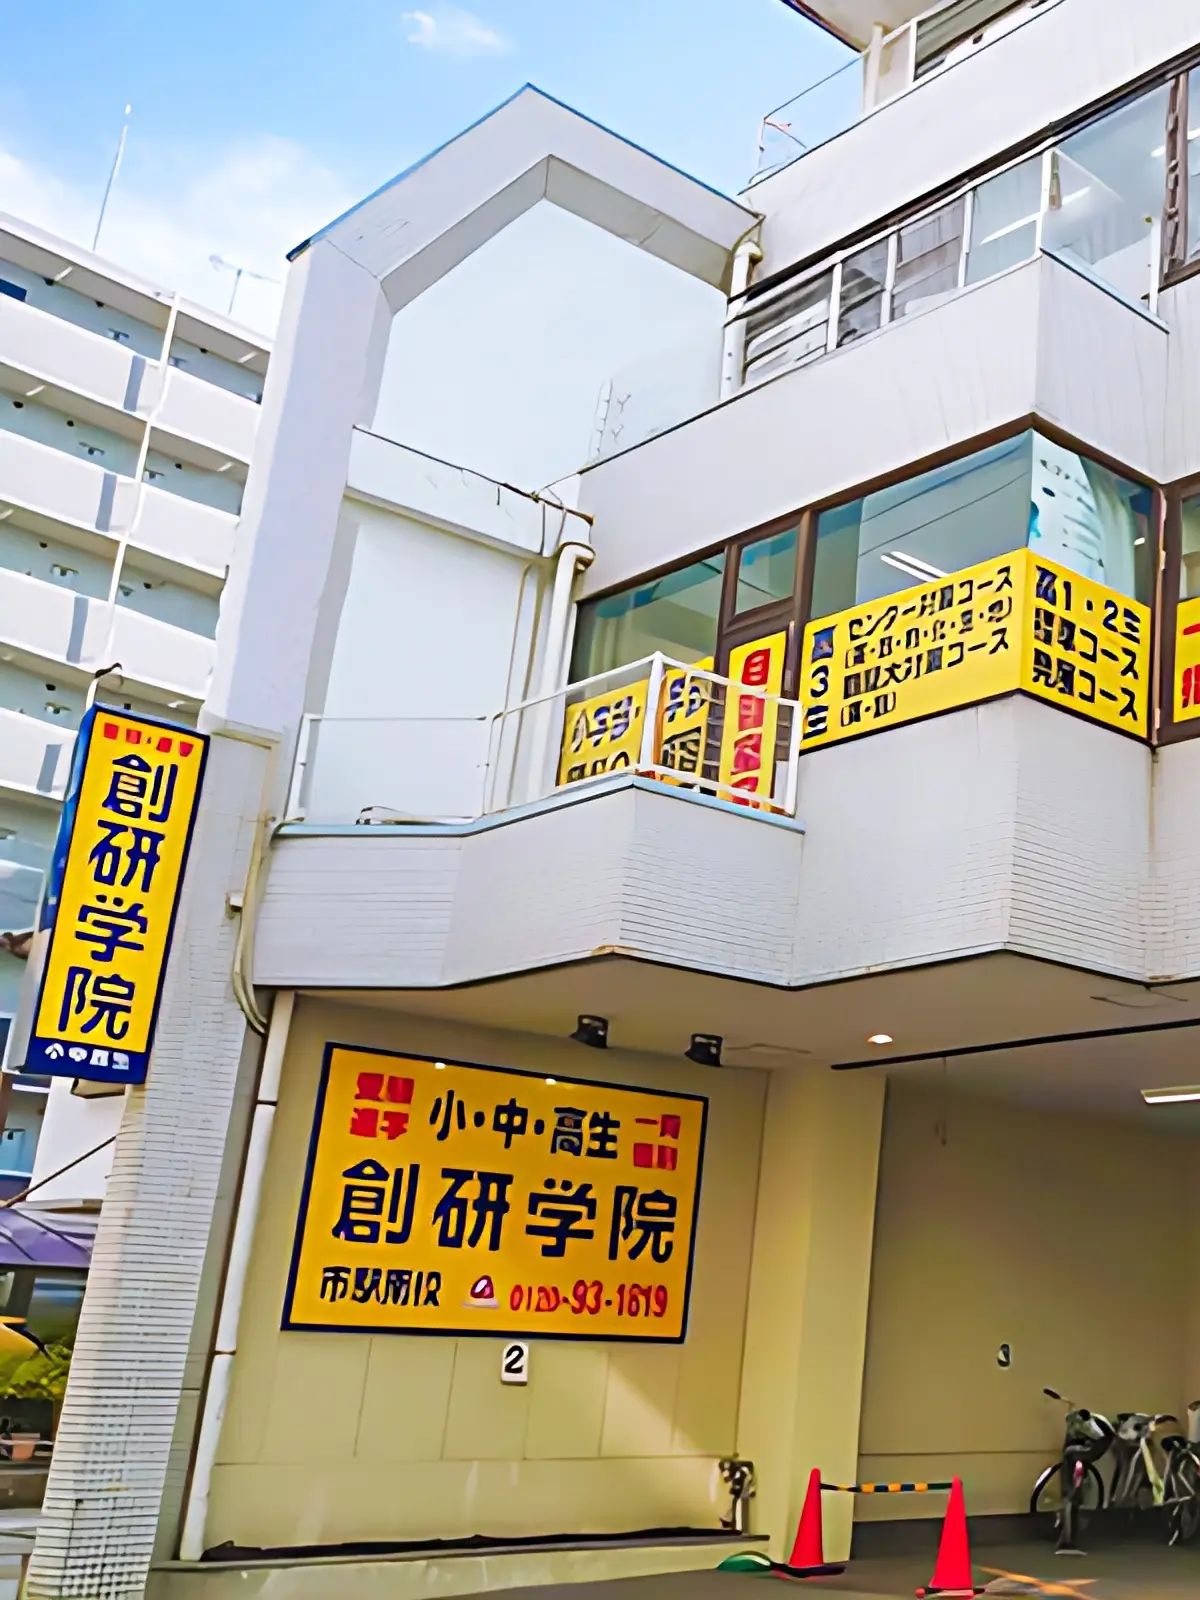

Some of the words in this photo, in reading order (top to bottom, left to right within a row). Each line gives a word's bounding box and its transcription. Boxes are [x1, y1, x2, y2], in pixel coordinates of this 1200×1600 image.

[58, 753, 178, 1041] 創研学院
[332, 1158, 678, 1263] 創研学院
[503, 1344, 526, 1375] 2
